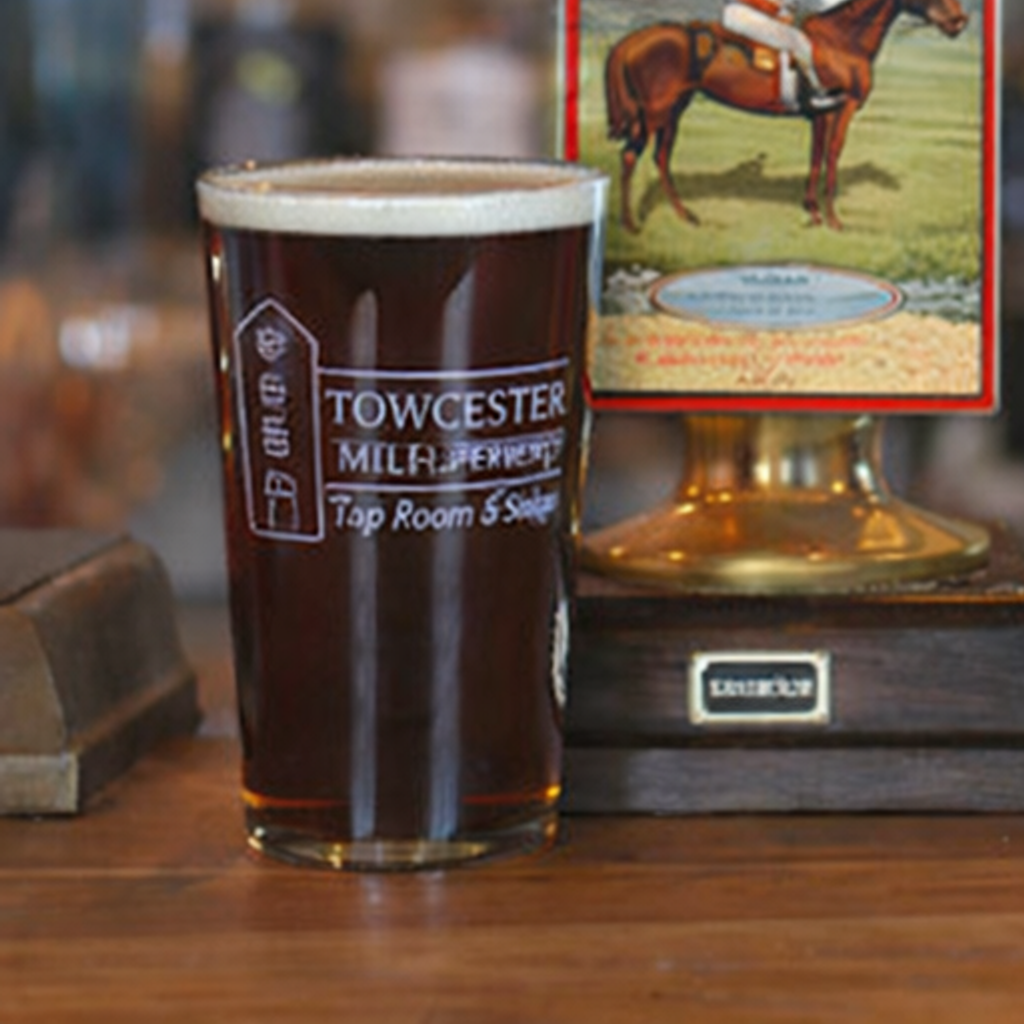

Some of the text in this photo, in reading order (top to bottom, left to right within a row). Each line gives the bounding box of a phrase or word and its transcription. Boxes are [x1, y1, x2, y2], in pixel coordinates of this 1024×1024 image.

[325, 380, 567, 431] TOWCESTER
[328, 494, 386, 537] Tap
[391, 497, 475, 531] Room
